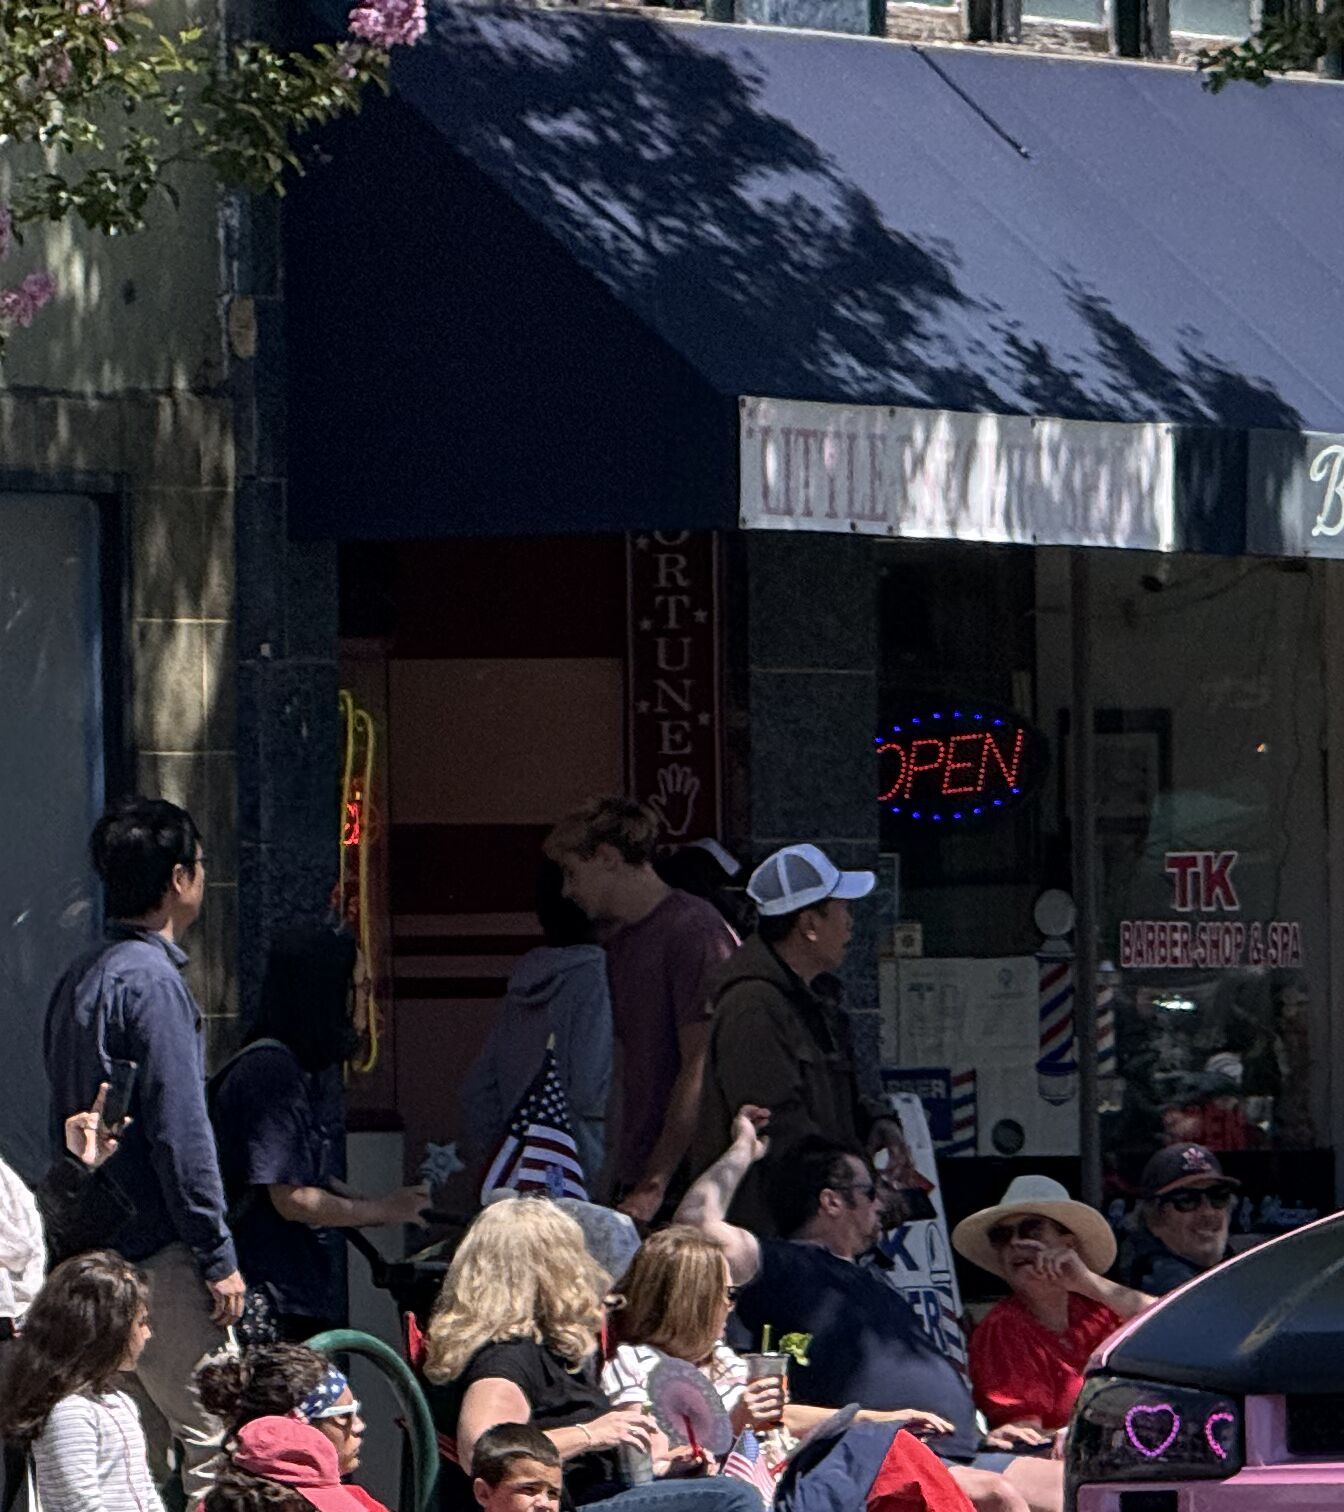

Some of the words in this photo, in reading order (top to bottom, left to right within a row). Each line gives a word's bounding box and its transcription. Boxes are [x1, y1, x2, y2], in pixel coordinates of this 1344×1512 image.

[876, 726, 1026, 804] OPEN
[1164, 850, 1241, 912] TK
[1120, 920, 1192, 969] BARBER
[1194, 920, 1245, 969] SHOP
[1267, 921, 1303, 969] SPA
